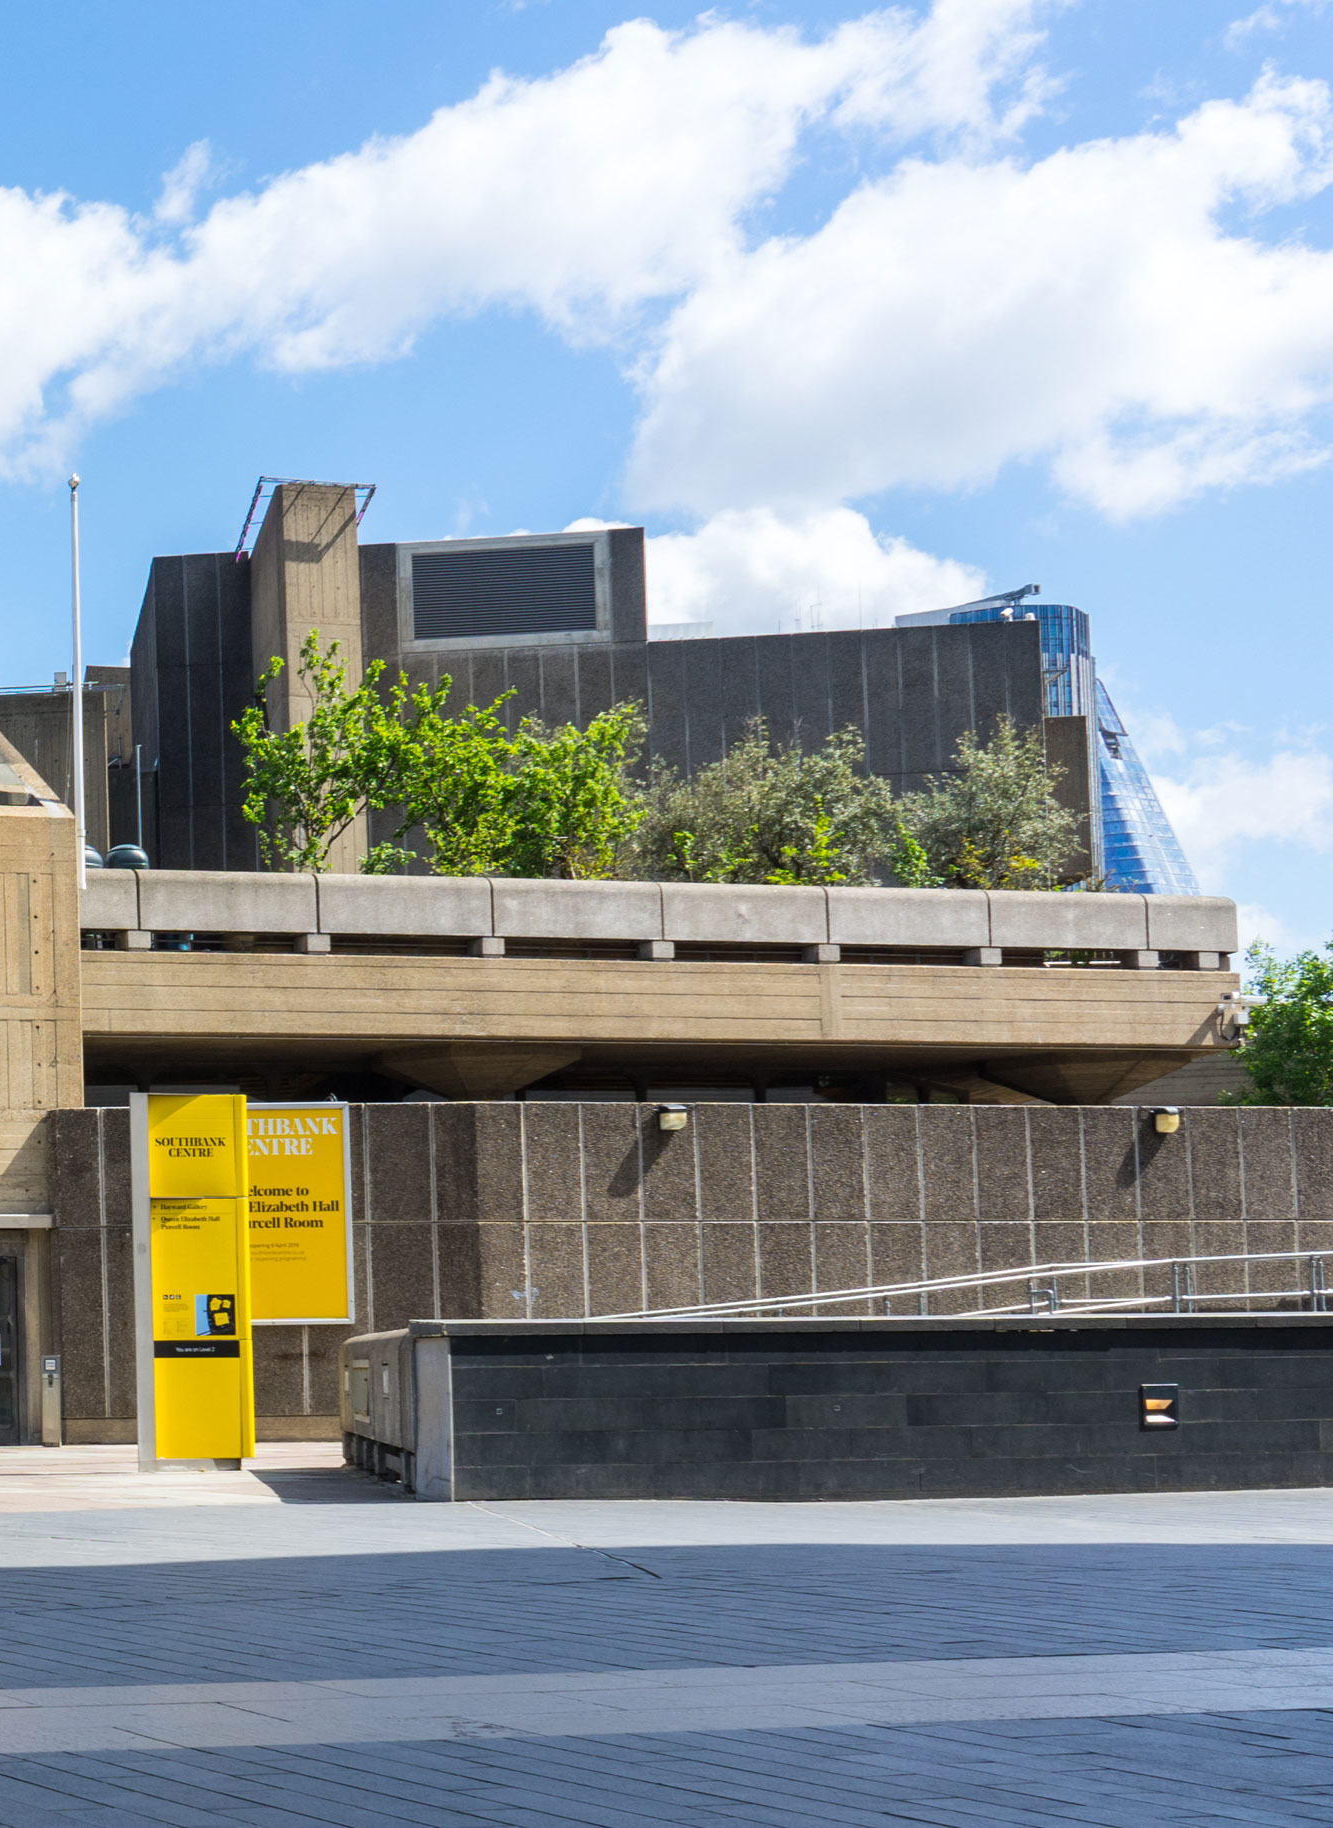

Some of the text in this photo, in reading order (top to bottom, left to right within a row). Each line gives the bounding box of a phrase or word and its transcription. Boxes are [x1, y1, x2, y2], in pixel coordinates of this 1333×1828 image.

[247, 1117, 338, 1136] THBANK
[155, 1137, 226, 1147] SOUTHBANK
[248, 1137, 313, 1155] NTRE
[168, 1148, 214, 1157] CENTRE
[249, 1185, 309, 1196] elcome to
[160, 1203, 186, 1211] Hayward
[249, 1200, 340, 1212] Elizabeth Hall
[249, 1217, 324, 1228] rcell Room
